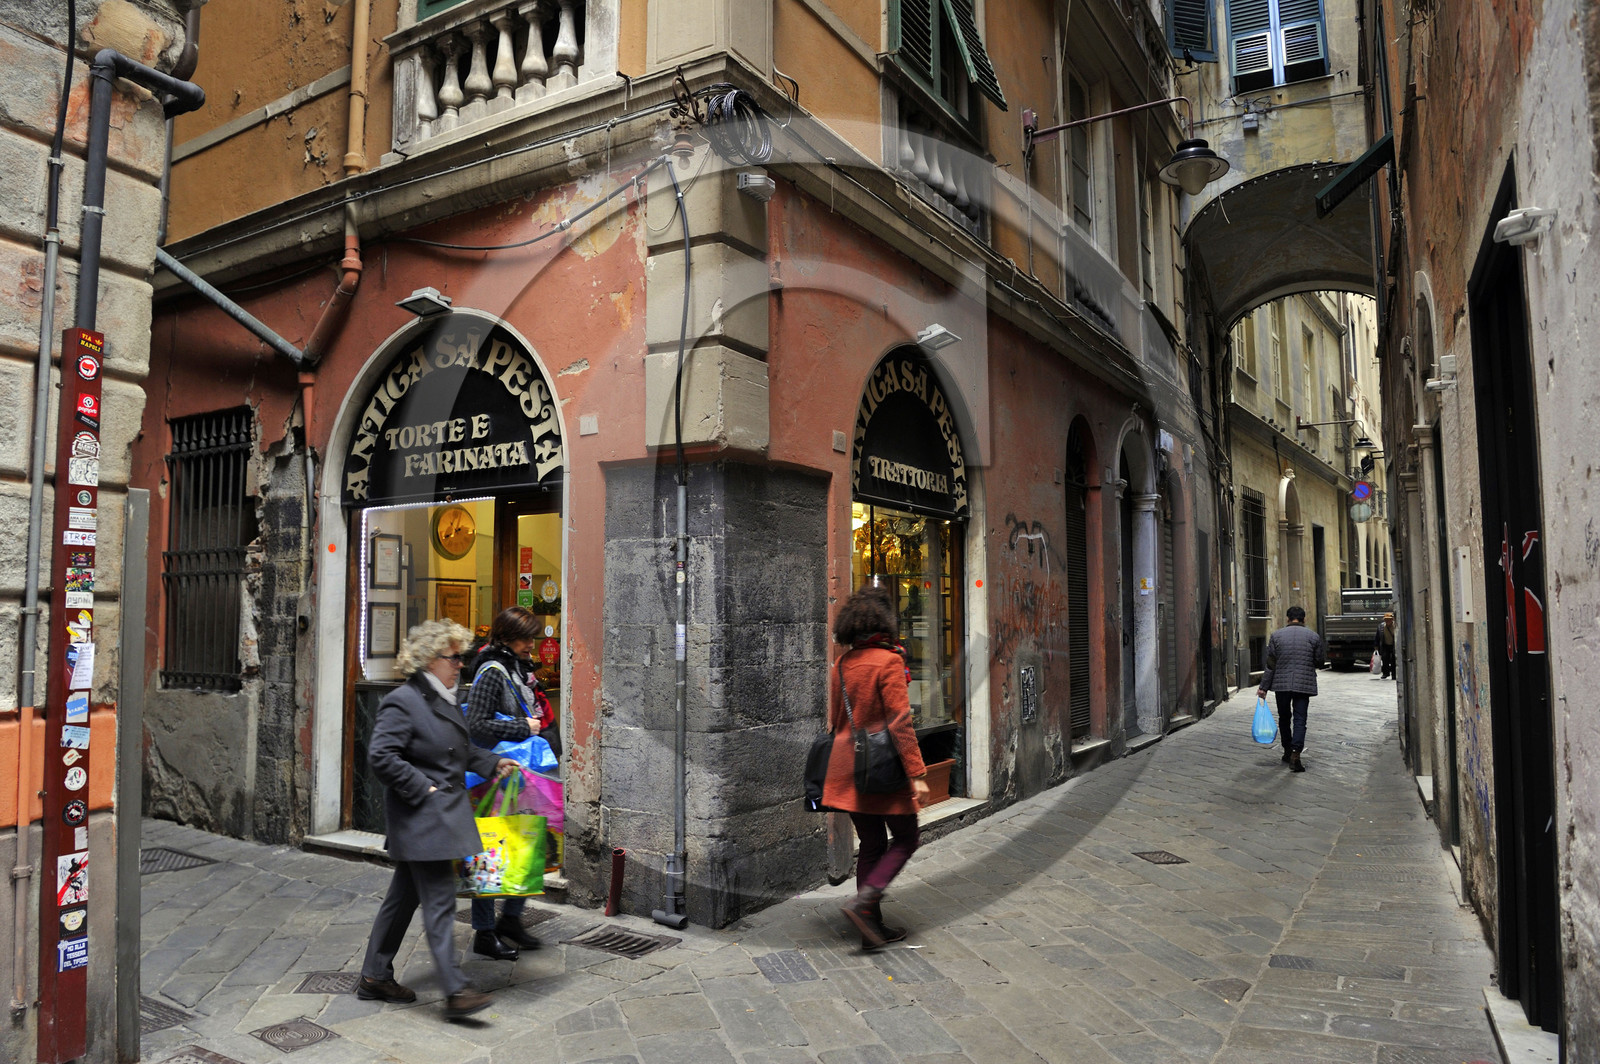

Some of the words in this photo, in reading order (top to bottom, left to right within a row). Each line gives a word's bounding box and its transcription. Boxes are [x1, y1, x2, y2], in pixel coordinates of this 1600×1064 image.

[346, 345, 434, 500] ANTICA
[482, 338, 563, 482] PESTA
[385, 418, 466, 451] TORTE
[471, 414, 490, 440] E
[404, 441, 530, 477] FARINATA
[929, 385, 968, 513] PESTA
[868, 455, 949, 495] TRATTORIA
